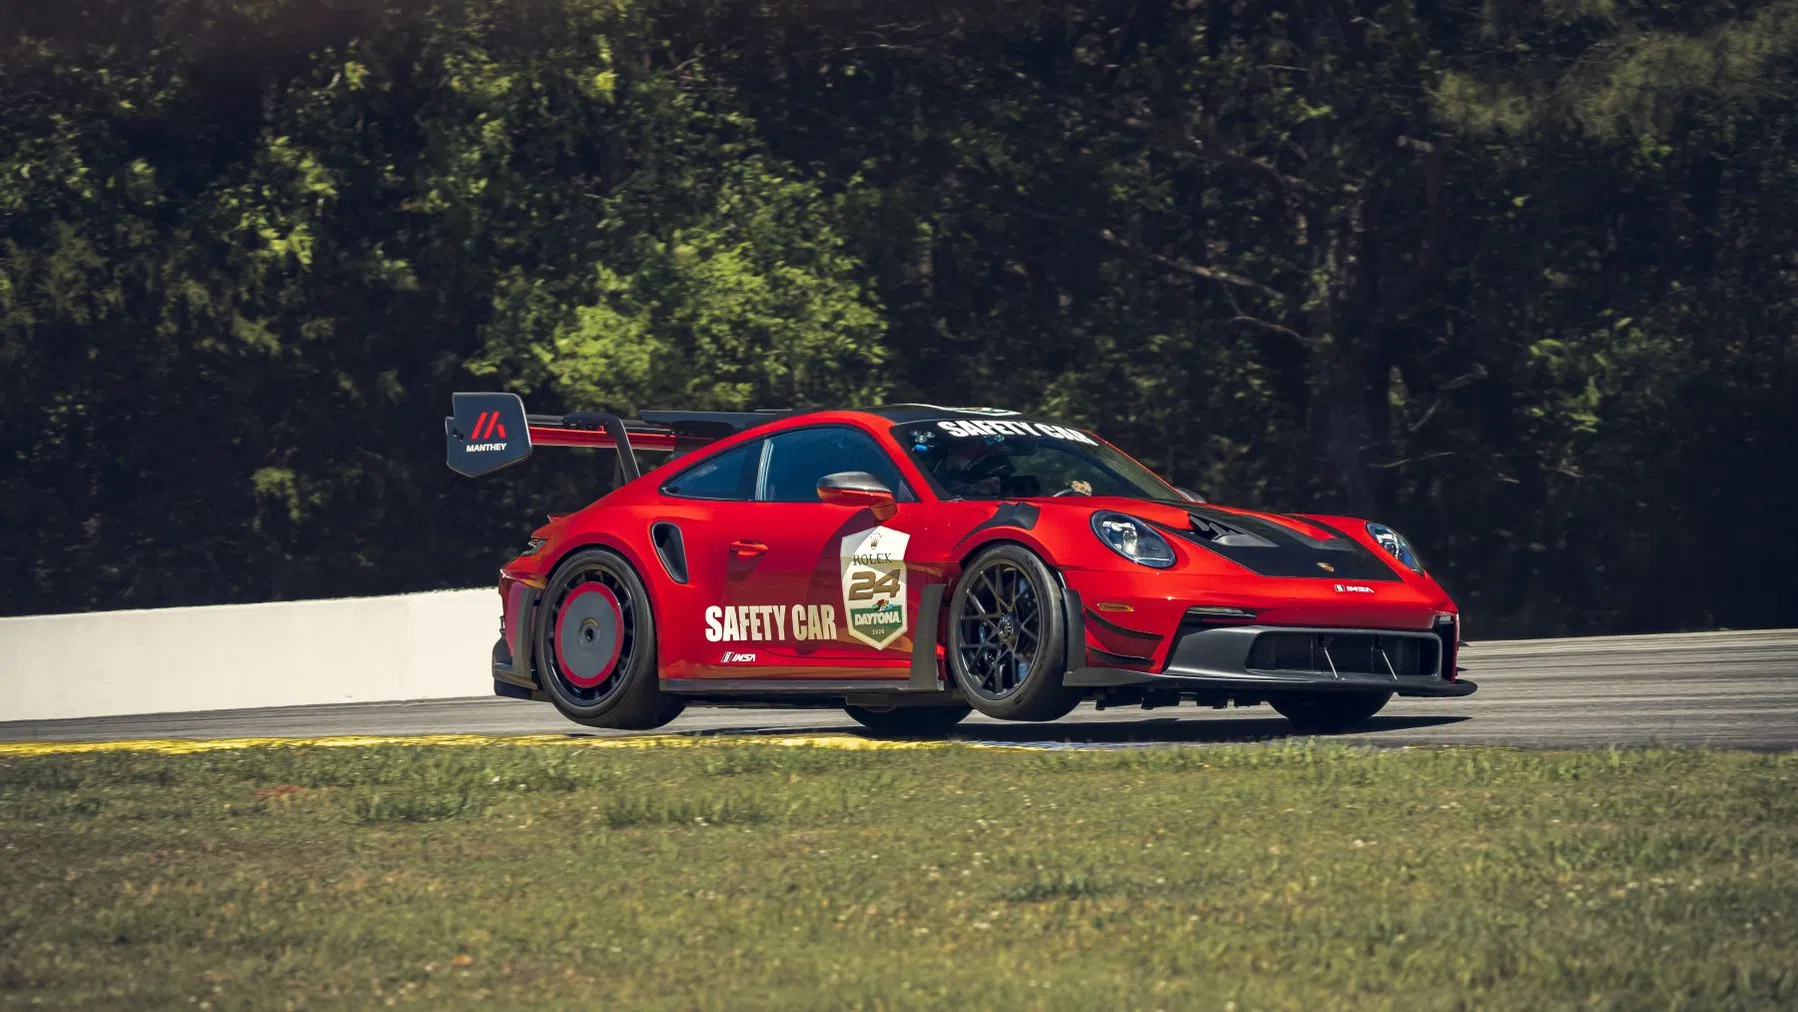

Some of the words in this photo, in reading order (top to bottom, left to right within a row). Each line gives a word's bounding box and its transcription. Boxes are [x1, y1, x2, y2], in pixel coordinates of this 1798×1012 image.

[937, 420, 1042, 437] SAFETY
[1034, 423, 1099, 446] CAR
[466, 443, 507, 452] MANTHEY
[852, 552, 892, 566] ROLEX
[849, 568, 901, 601] 24
[705, 605, 786, 642] SAFETY
[792, 604, 837, 641] CAR
[855, 611, 901, 626] DAYTONA
[732, 653, 756, 662] IMSA
